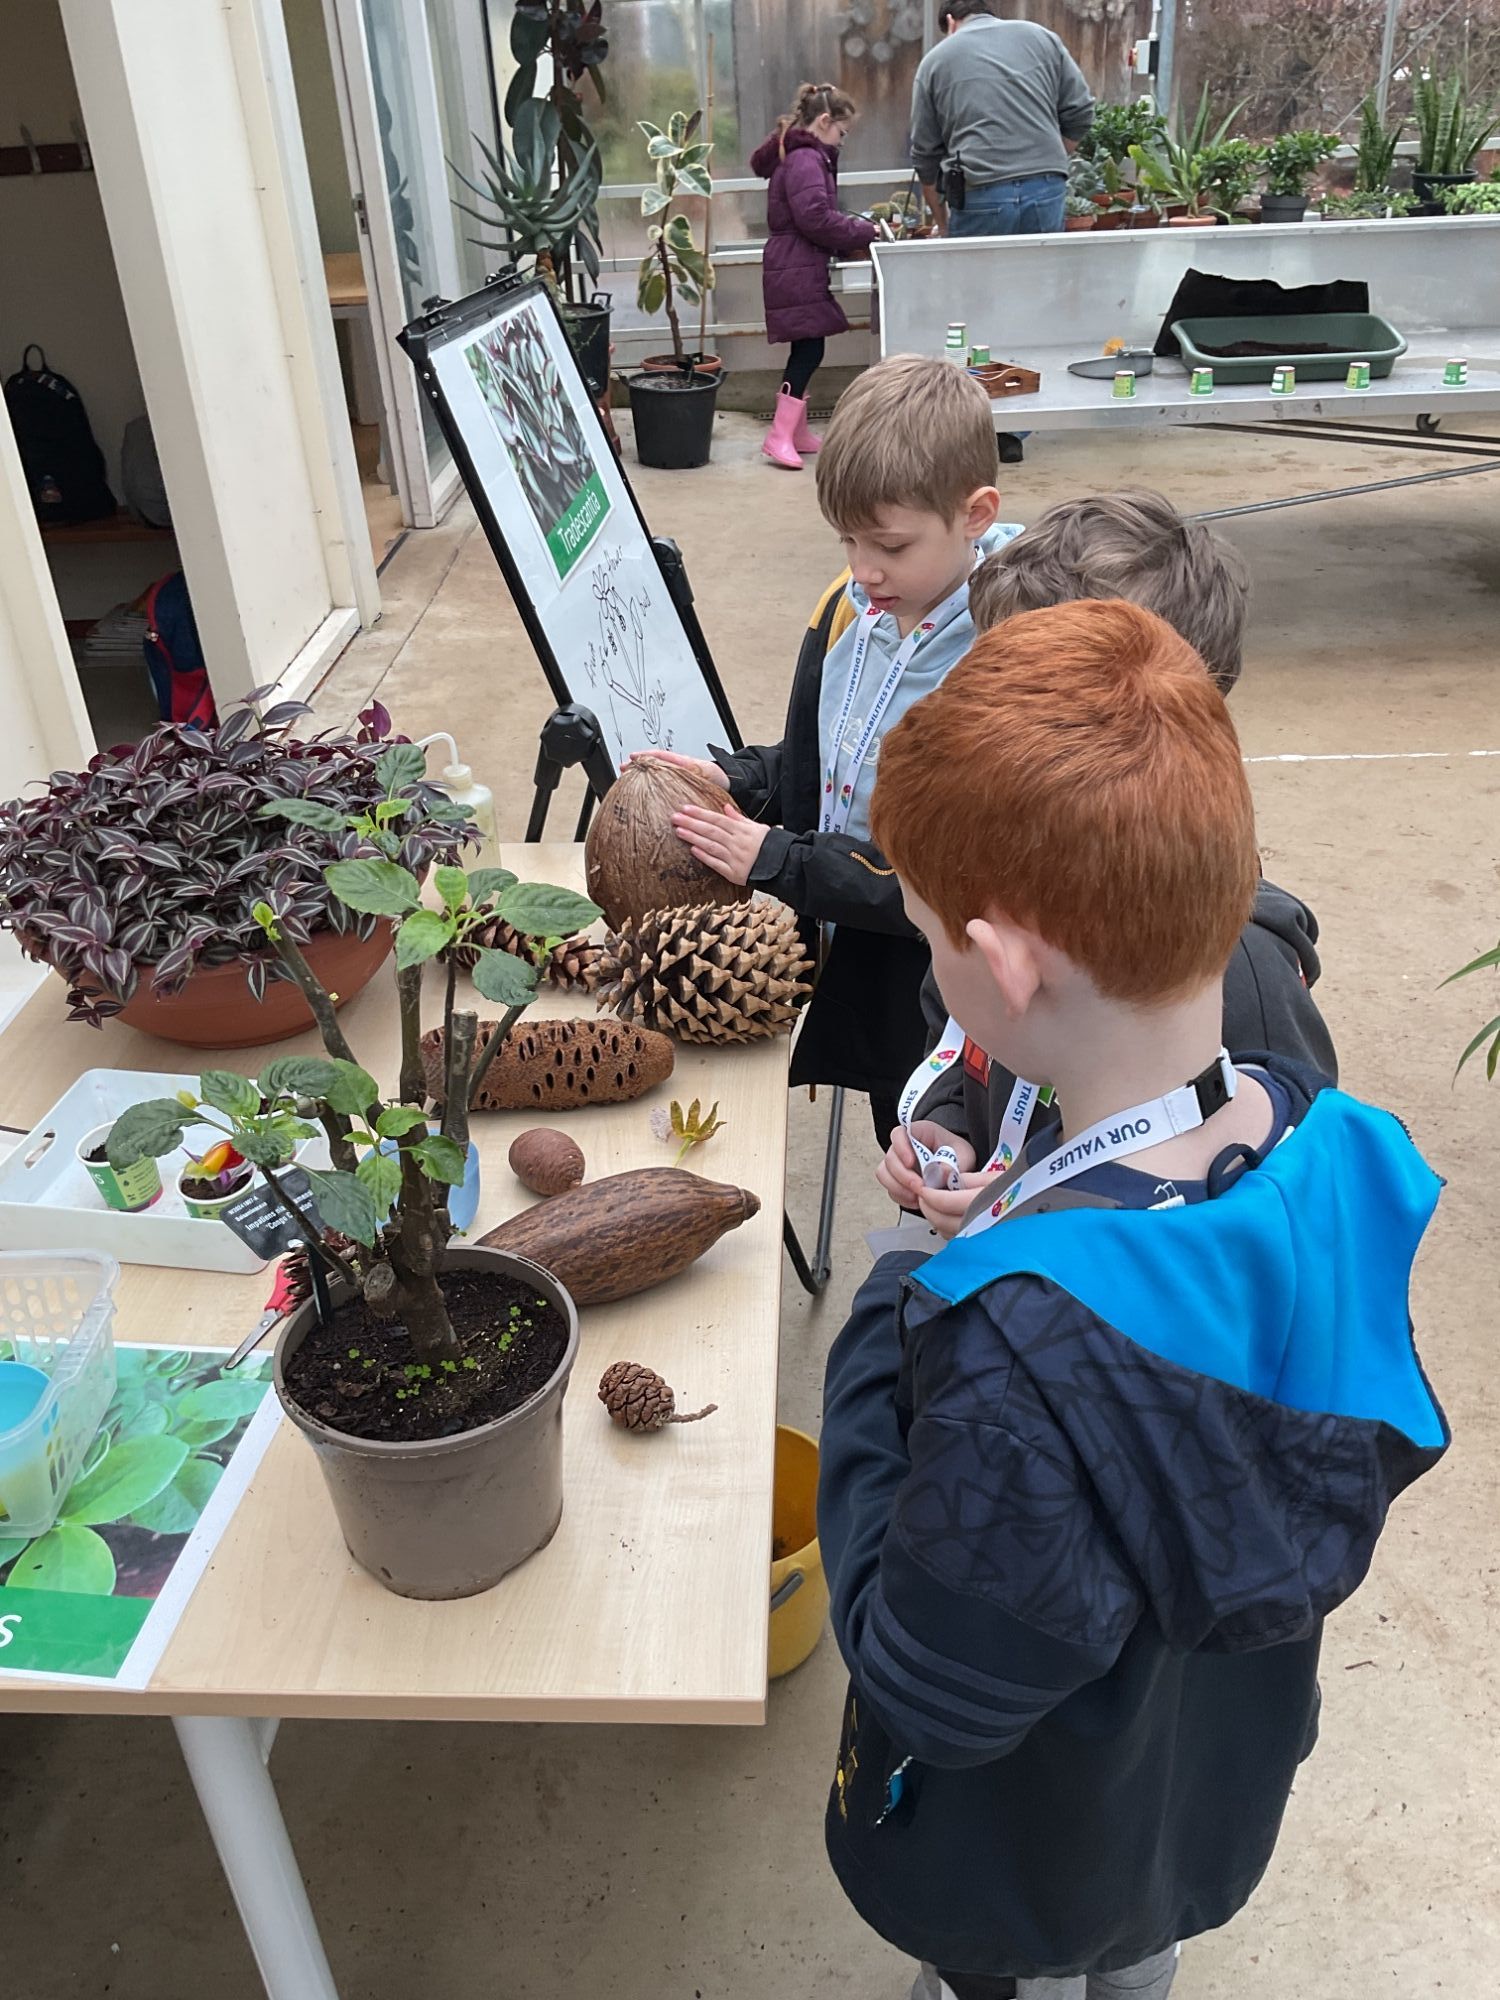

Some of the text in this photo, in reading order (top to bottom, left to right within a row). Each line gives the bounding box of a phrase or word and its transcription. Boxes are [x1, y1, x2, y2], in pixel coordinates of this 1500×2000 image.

[557, 489, 601, 555] Tradescantia
[857, 638, 865, 656] THE
[842, 658, 862, 717] DISABILITIES
[853, 660, 903, 765] THE DISABILITIES TRUST
[1012, 1084, 1032, 1125] TRUST
[1049, 1118, 1152, 1176] OUR VALUES
[244, 1211, 277, 1231] Impatiens
